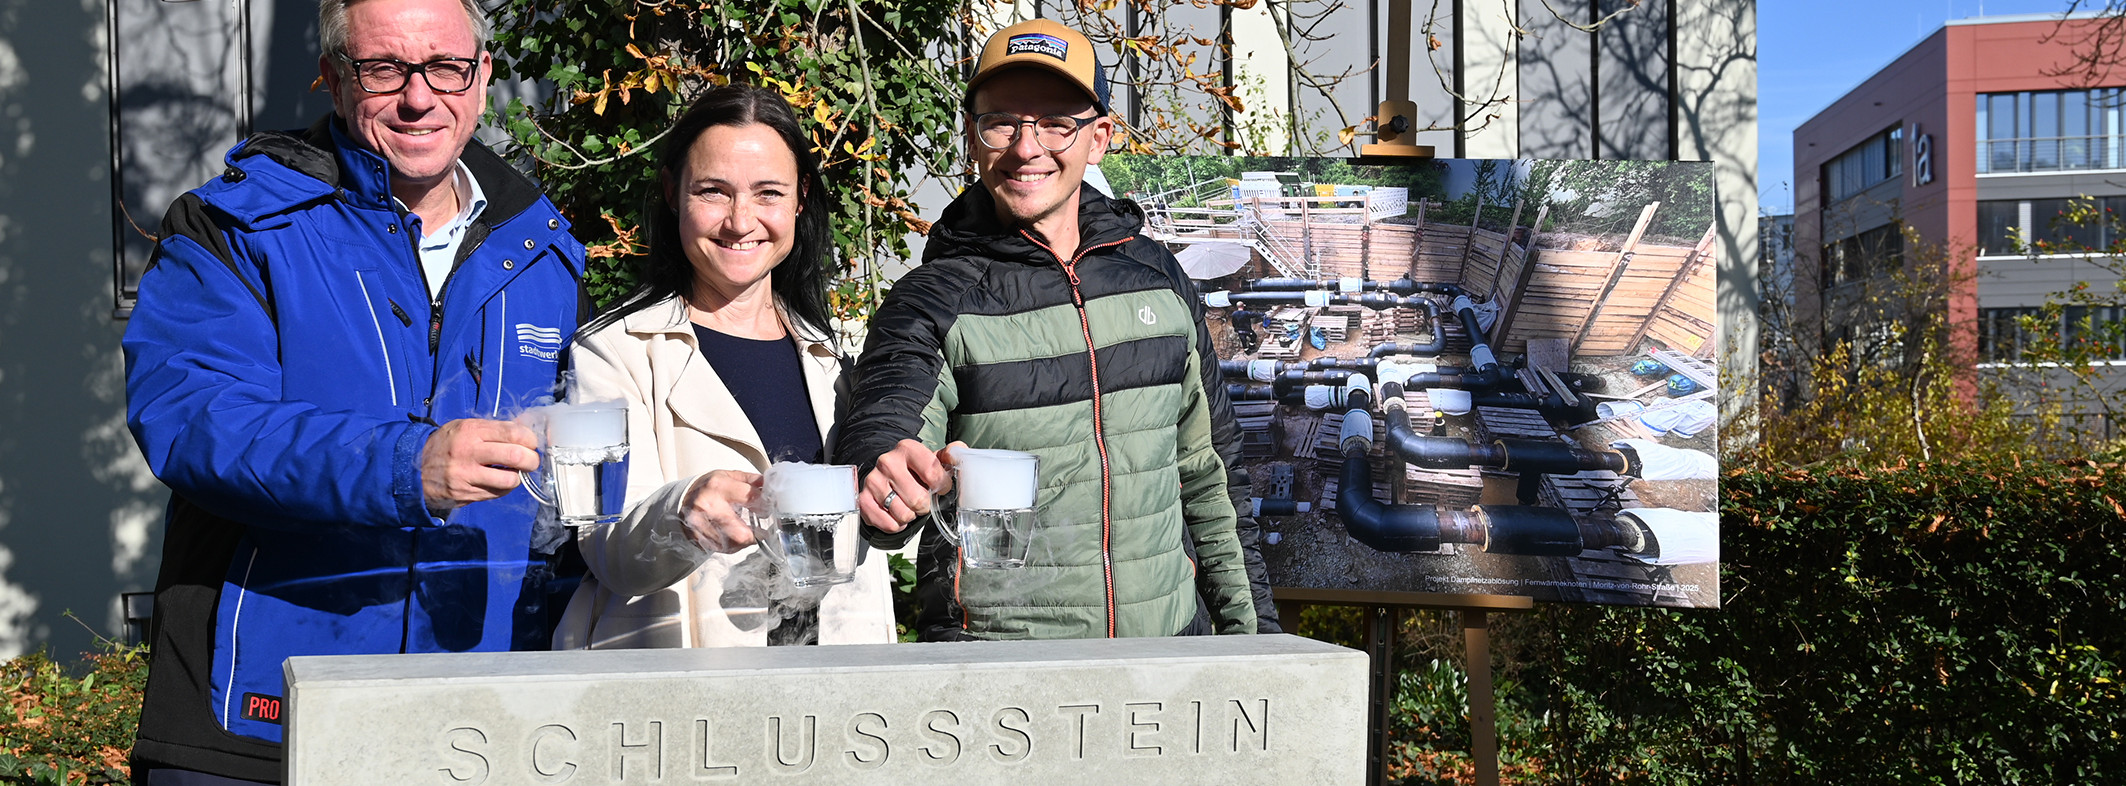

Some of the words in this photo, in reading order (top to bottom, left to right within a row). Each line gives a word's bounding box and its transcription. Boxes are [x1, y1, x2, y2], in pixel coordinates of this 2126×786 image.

[1010, 44, 1063, 58] patagonia
[1909, 122, 1931, 187] 1a
[1425, 575, 1449, 584] Projekt
[1450, 575, 1519, 587] Dampfnetzablösung
[1525, 578, 1587, 588] Fernwärmeknoten
[248, 696, 280, 720] PRO
[438, 698, 1269, 786] SCHLUSSSTEIN
